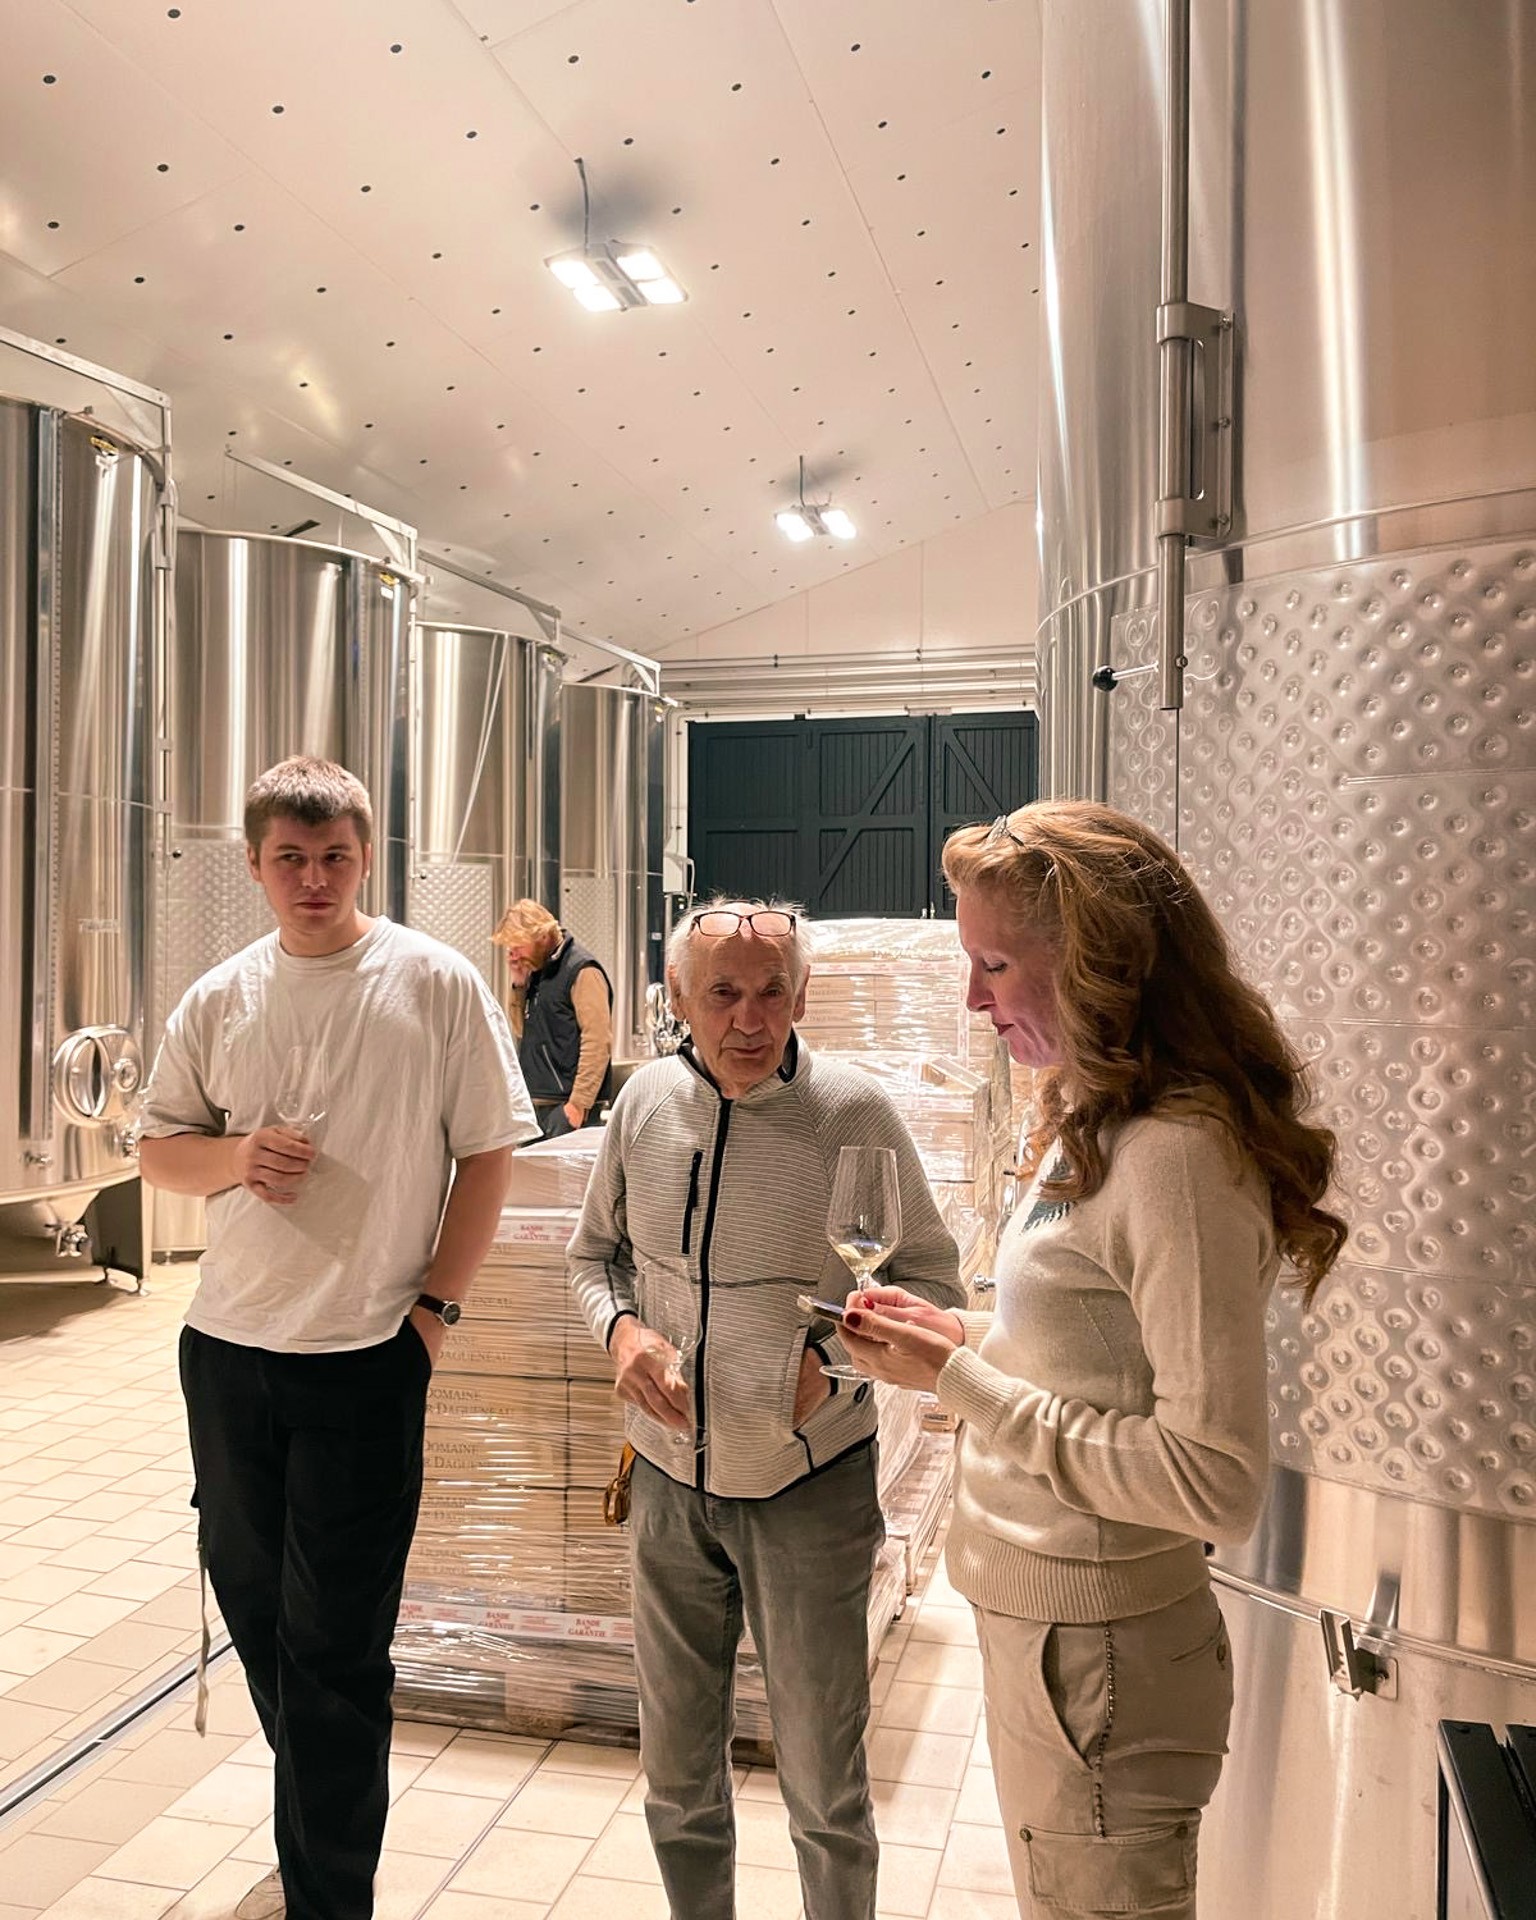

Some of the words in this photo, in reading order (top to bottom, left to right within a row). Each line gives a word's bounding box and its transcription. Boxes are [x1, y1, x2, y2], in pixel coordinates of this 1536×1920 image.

[486, 1612, 510, 1620] BANDE
[575, 1618, 600, 1627] BANDE
[568, 1627, 606, 1638] GARANTIE
